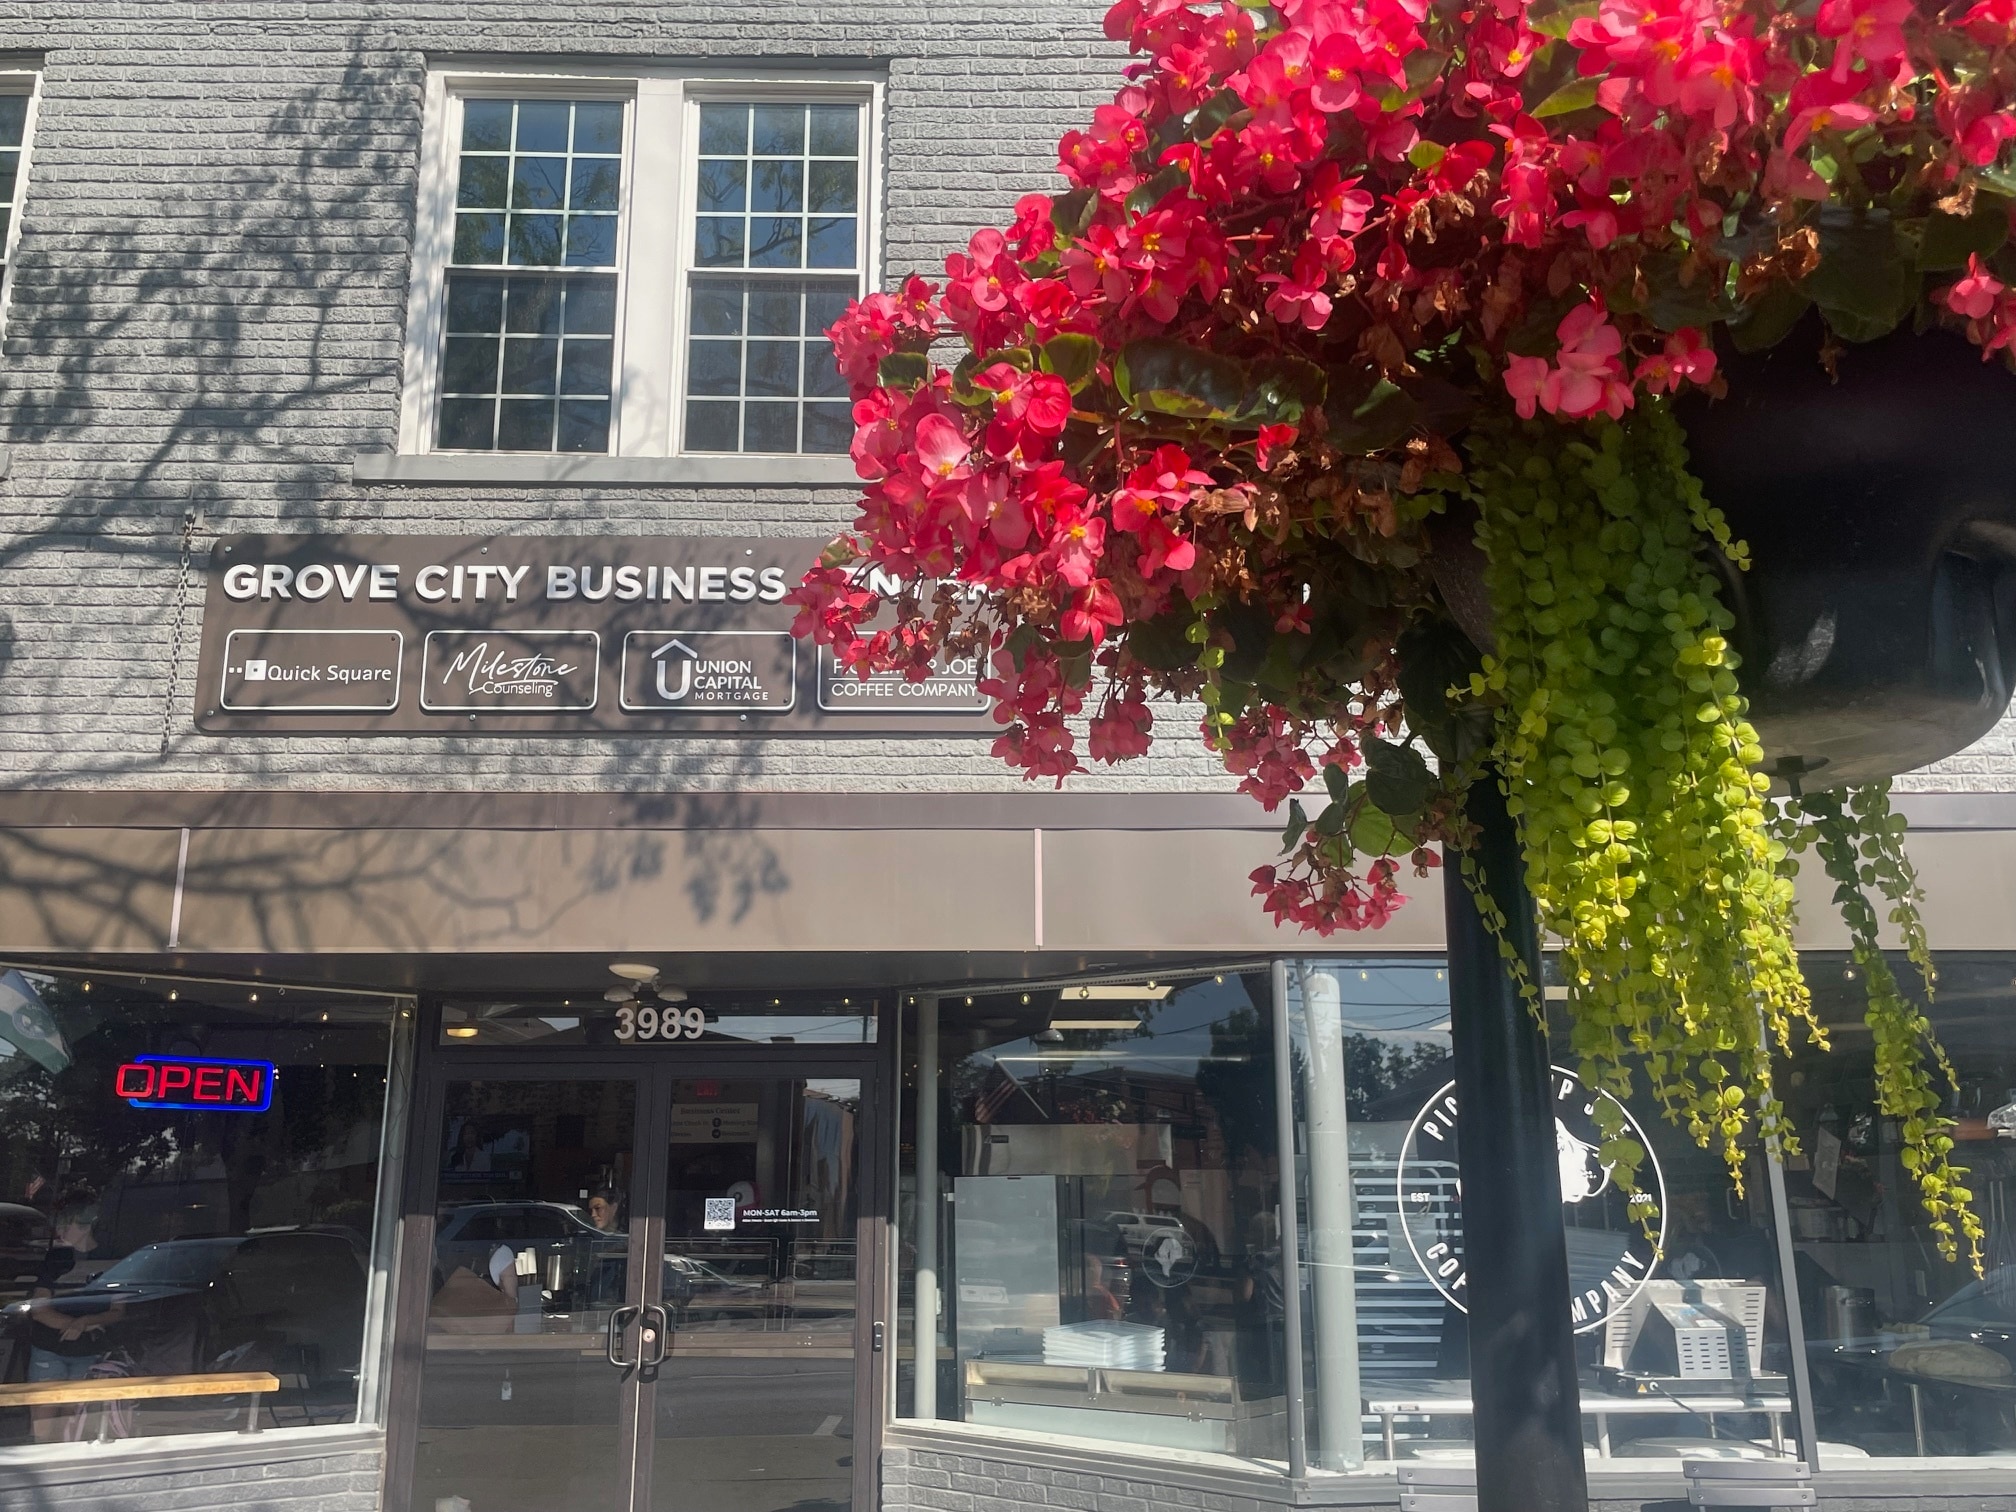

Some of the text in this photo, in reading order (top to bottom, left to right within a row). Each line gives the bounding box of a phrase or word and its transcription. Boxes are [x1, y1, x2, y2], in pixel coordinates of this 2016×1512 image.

[223, 564, 400, 600] GROVE
[415, 565, 530, 600] CITY
[546, 565, 787, 600] BUSINESS
[442, 642, 578, 695] Milestone
[695, 660, 752, 674] UNION
[941, 658, 978, 675] JOE
[268, 664, 392, 686] Quick Square
[694, 676, 762, 690] CAPITAL
[482, 681, 554, 697] Counseling
[694, 692, 769, 701] MORTGAGE
[831, 683, 978, 697] COFFEE COMPANY
[614, 1007, 705, 1040] 3989
[115, 1063, 261, 1103] OPEN
[1410, 1192, 1431, 1203] EST
[743, 1209, 818, 1218] MON-SAT 6am-3pm
